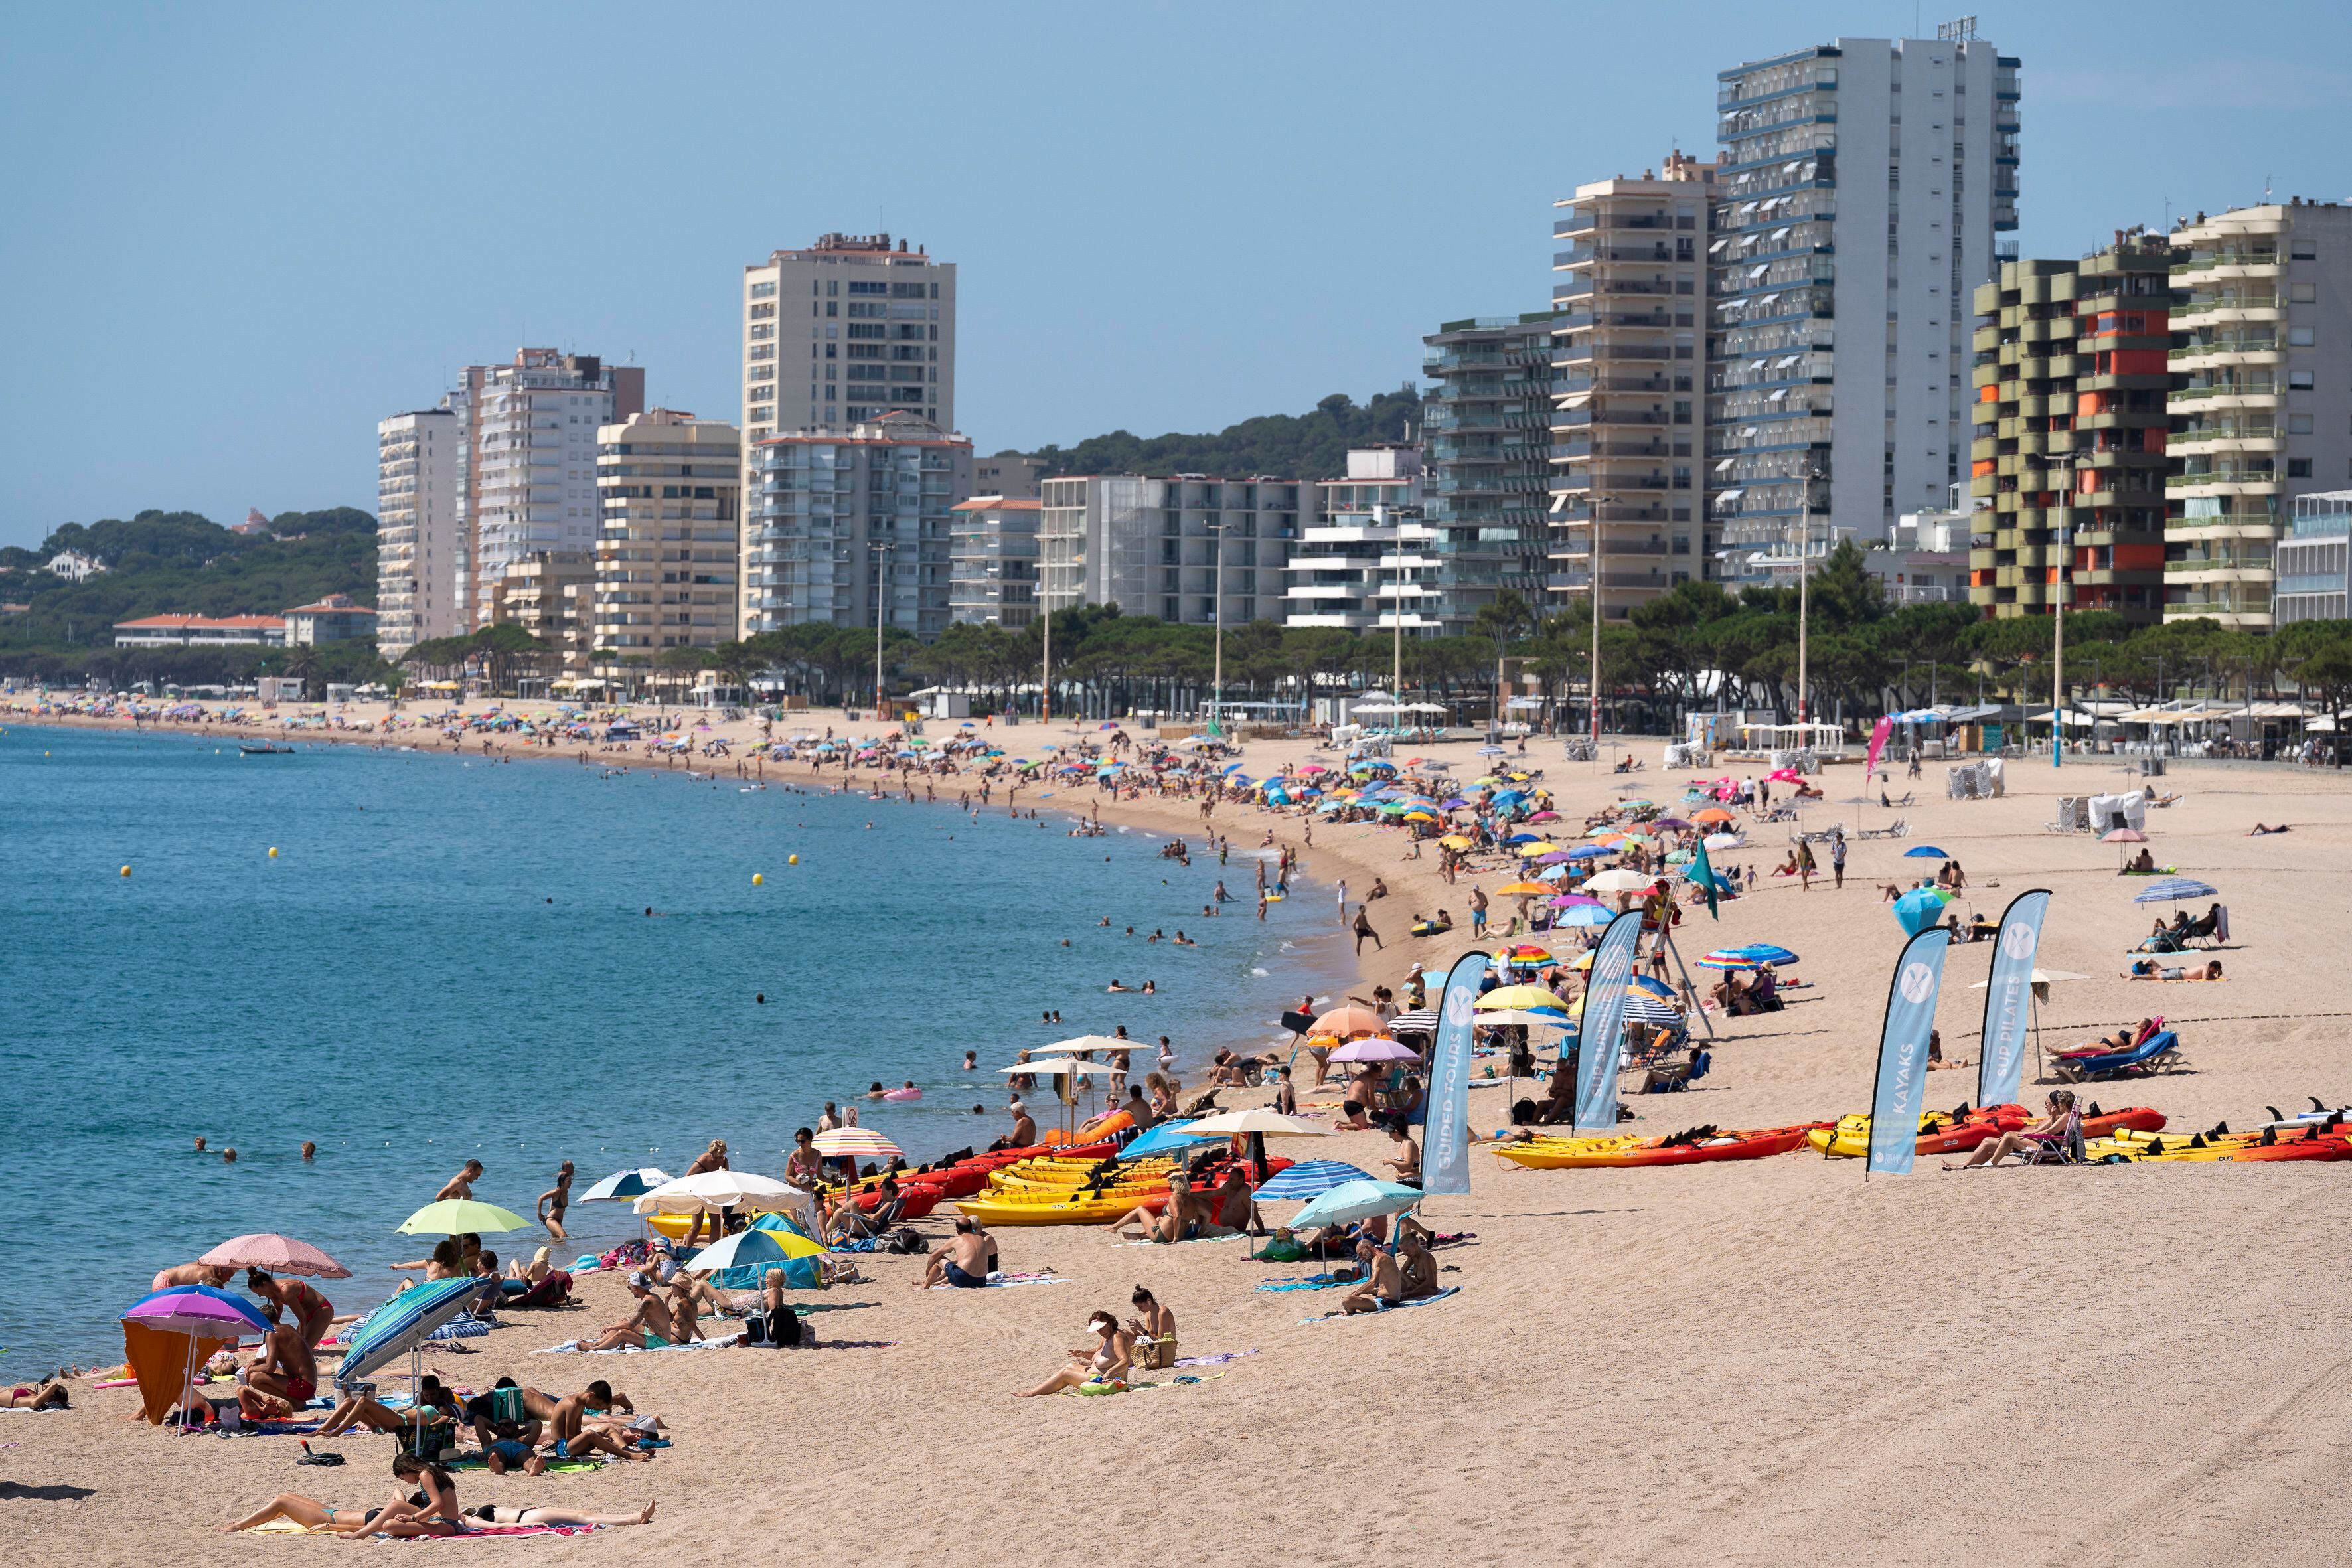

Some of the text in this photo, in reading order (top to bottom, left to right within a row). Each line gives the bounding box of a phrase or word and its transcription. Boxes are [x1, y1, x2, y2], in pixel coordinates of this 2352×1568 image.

[2000, 976, 2020, 1042] PILATES
[1445, 1032, 1462, 1093] TOURS
[1591, 1065, 1604, 1097] SUP
[1893, 1044, 1914, 1115] KAYAKS
[1997, 1048, 2010, 1077] SUP
[1438, 1099, 1454, 1170] GUIDED
